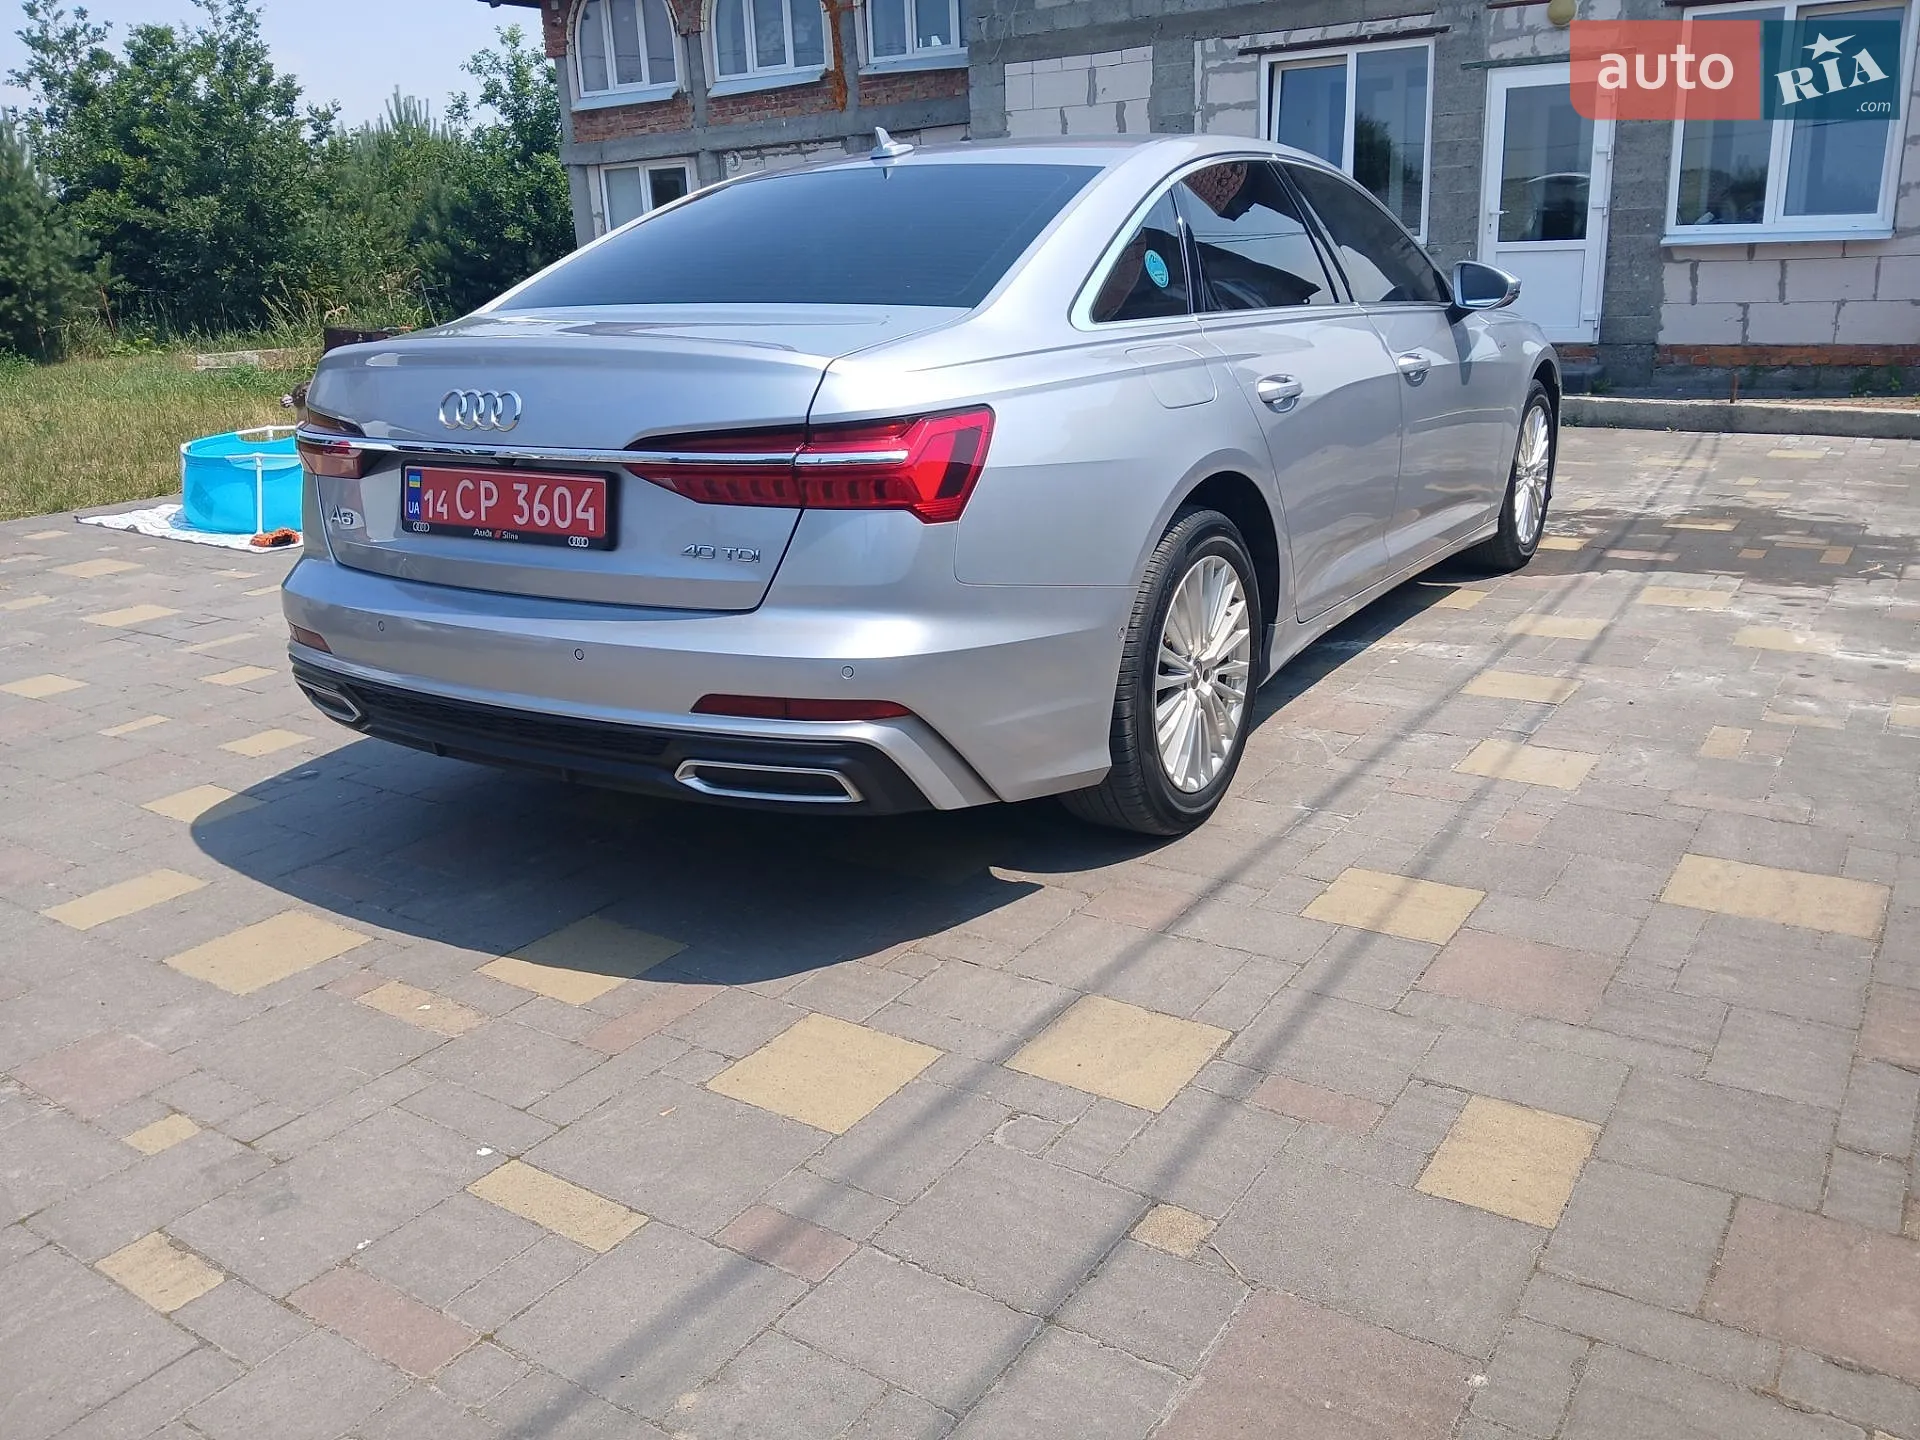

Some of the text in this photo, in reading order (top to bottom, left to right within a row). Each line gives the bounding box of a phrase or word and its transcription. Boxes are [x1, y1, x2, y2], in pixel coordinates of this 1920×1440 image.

[408, 501, 420, 514] UA
[424, 479, 595, 531] 14 CP 3604
[473, 528, 493, 538] Audi
[680, 543, 761, 563] 40 TDI
